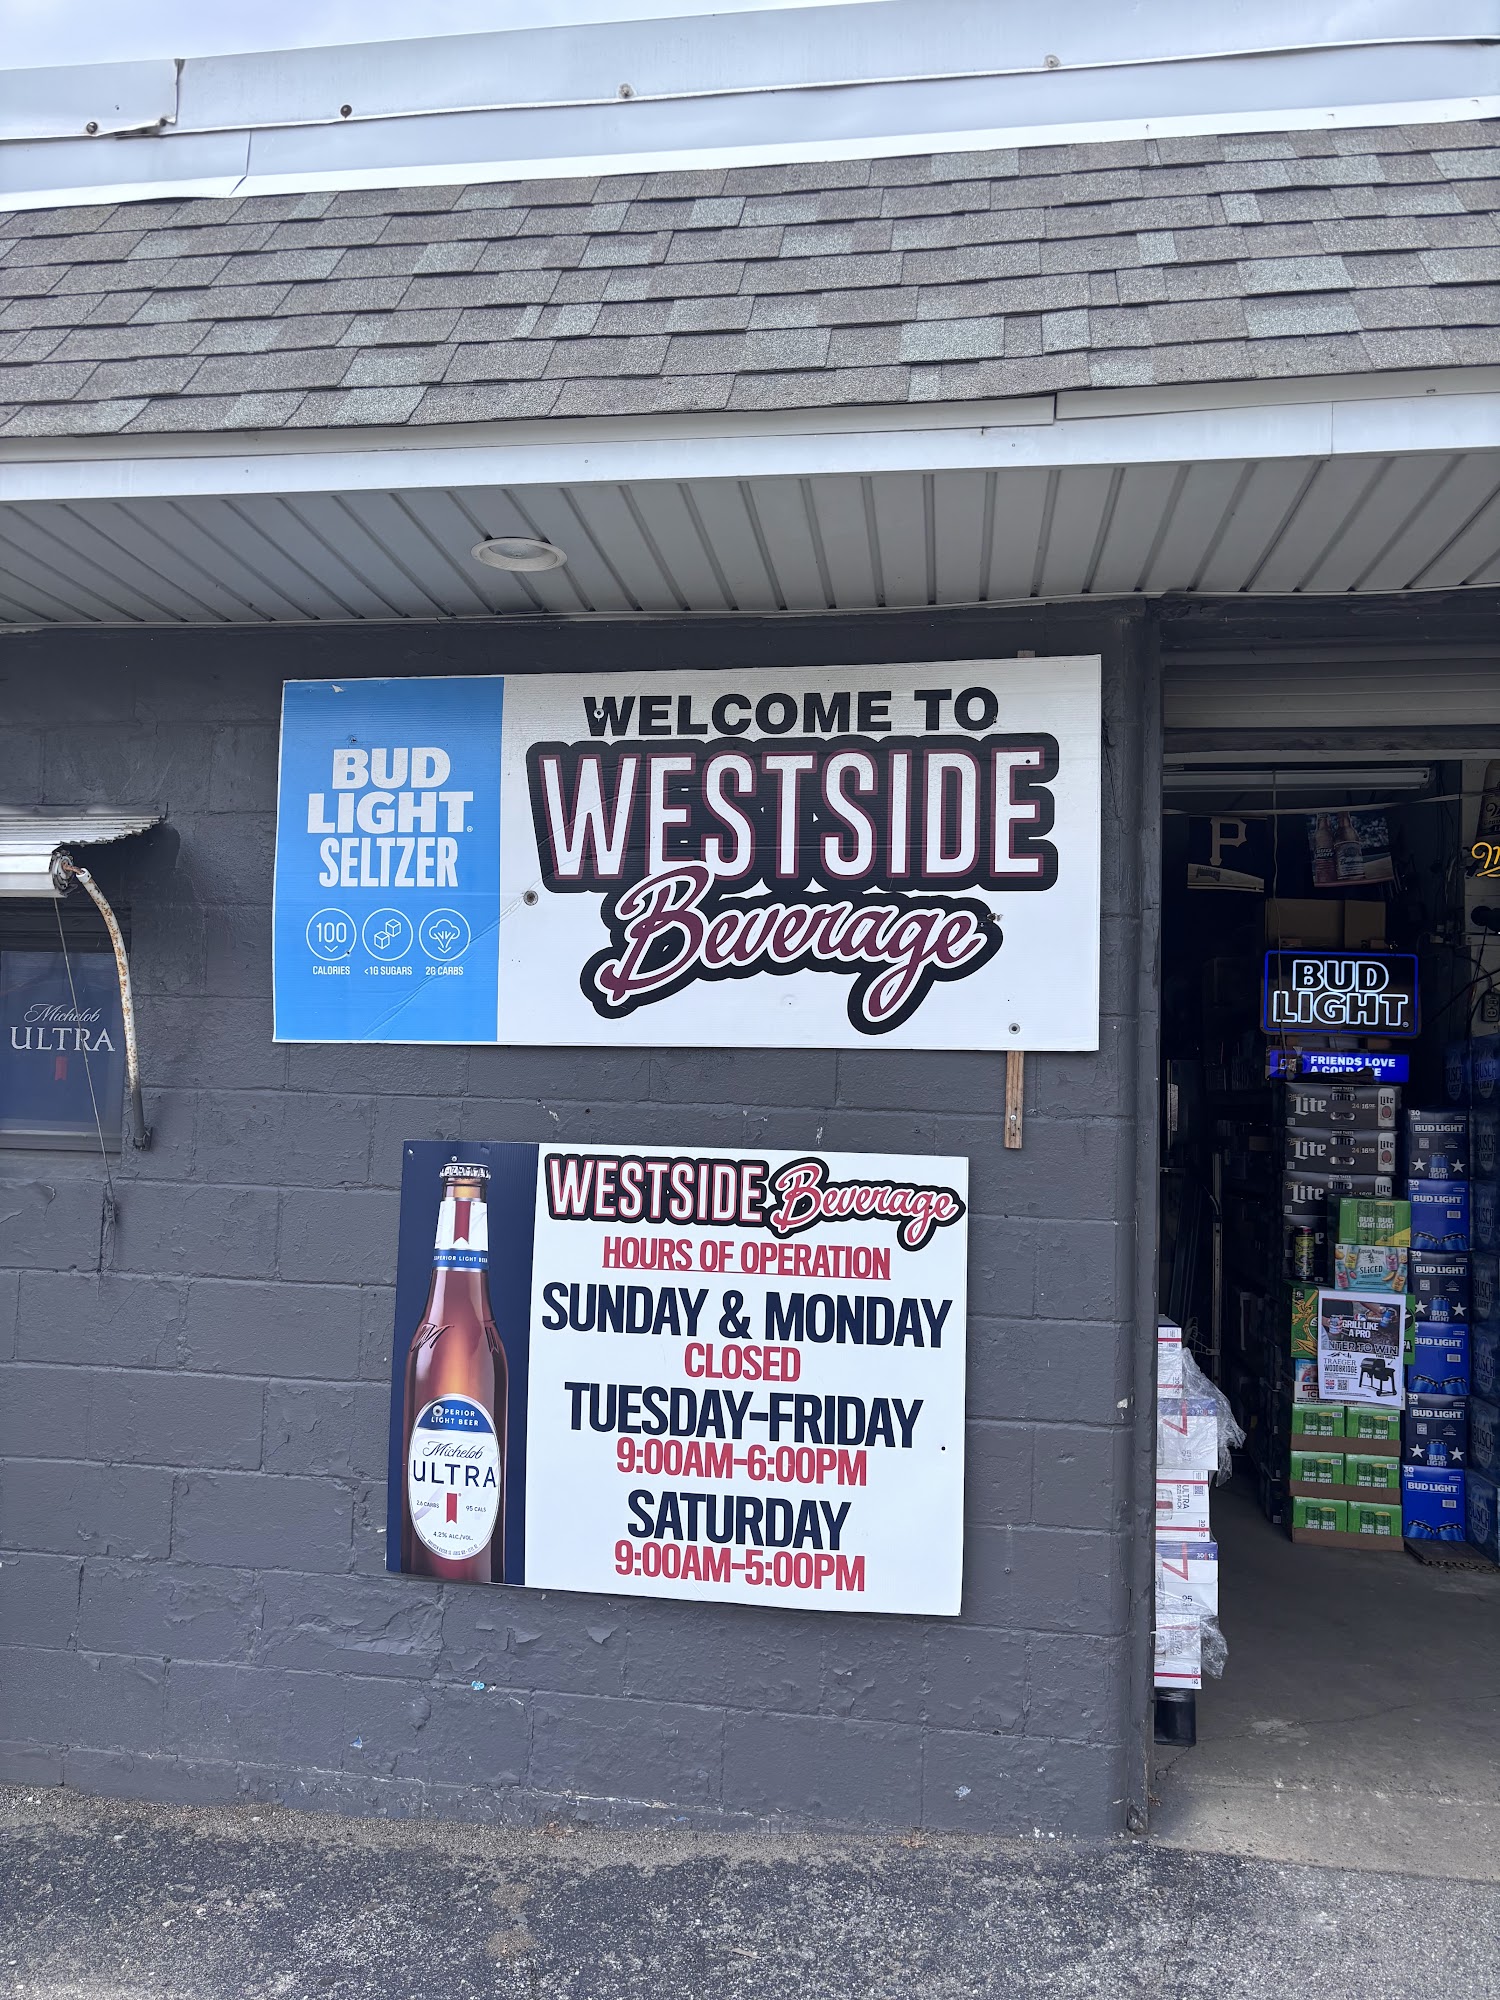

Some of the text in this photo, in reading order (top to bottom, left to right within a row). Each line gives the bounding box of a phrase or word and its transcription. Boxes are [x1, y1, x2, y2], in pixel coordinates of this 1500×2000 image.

[582, 687, 999, 737] WELCOME TO
[332, 747, 451, 789] BUD
[307, 791, 473, 834] LIGHT
[538, 746, 1045, 880] WESTSIDE
[1210, 815, 1247, 866] P
[319, 837, 458, 887] SELTZER
[316, 922, 347, 943] 100
[594, 861, 988, 1022] Beverage
[312, 965, 350, 975] CALORIES
[364, 966, 412, 976] <1G SUGARS
[425, 966, 464, 976] 2G CARBS
[1292, 960, 1389, 993] BUD
[23, 1003, 102, 1023] Michelob
[1273, 991, 1408, 1026] LIGHT
[10, 1026, 115, 1052] ULTRA
[1310, 1055, 1396, 1067] FRIENDS LOVE
[1294, 1096, 1327, 1116] Lite
[1380, 1096, 1394, 1105] Lite
[1414, 1124, 1435, 1132] BUD
[1294, 1140, 1327, 1160] Lite
[1380, 1140, 1394, 1149] Lite
[1291, 1184, 1324, 1204] Lite
[1377, 1184, 1391, 1194] Lite
[548, 1157, 960, 1245] WESTSIDE Beverage
[1434, 1195, 1461, 1204] LIGHT
[603, 1236, 891, 1279] HOURS OF OPERATION
[1437, 1266, 1465, 1274] LIGHT
[542, 1282, 953, 1348] SUNDAY & MONDAY
[1342, 1320, 1379, 1331] GRILL LIKE
[1348, 1329, 1370, 1338] A PRO
[1373, 1344, 1398, 1356] WIN
[1415, 1337, 1433, 1345] BUD
[1434, 1338, 1461, 1347] LIGHT
[684, 1342, 801, 1382] CLOSED
[430, 1416, 479, 1427] LIGHT BEER
[434, 1406, 475, 1417] PERIOR
[1412, 1409, 1462, 1419] BUD LIGHT
[422, 1441, 486, 1460] Michelob
[413, 1459, 497, 1488] ULTRA
[1182, 1485, 1190, 1509] ULTRA
[1408, 1482, 1458, 1493] BUD LIGHT
[628, 1489, 851, 1551] SATURDAY
